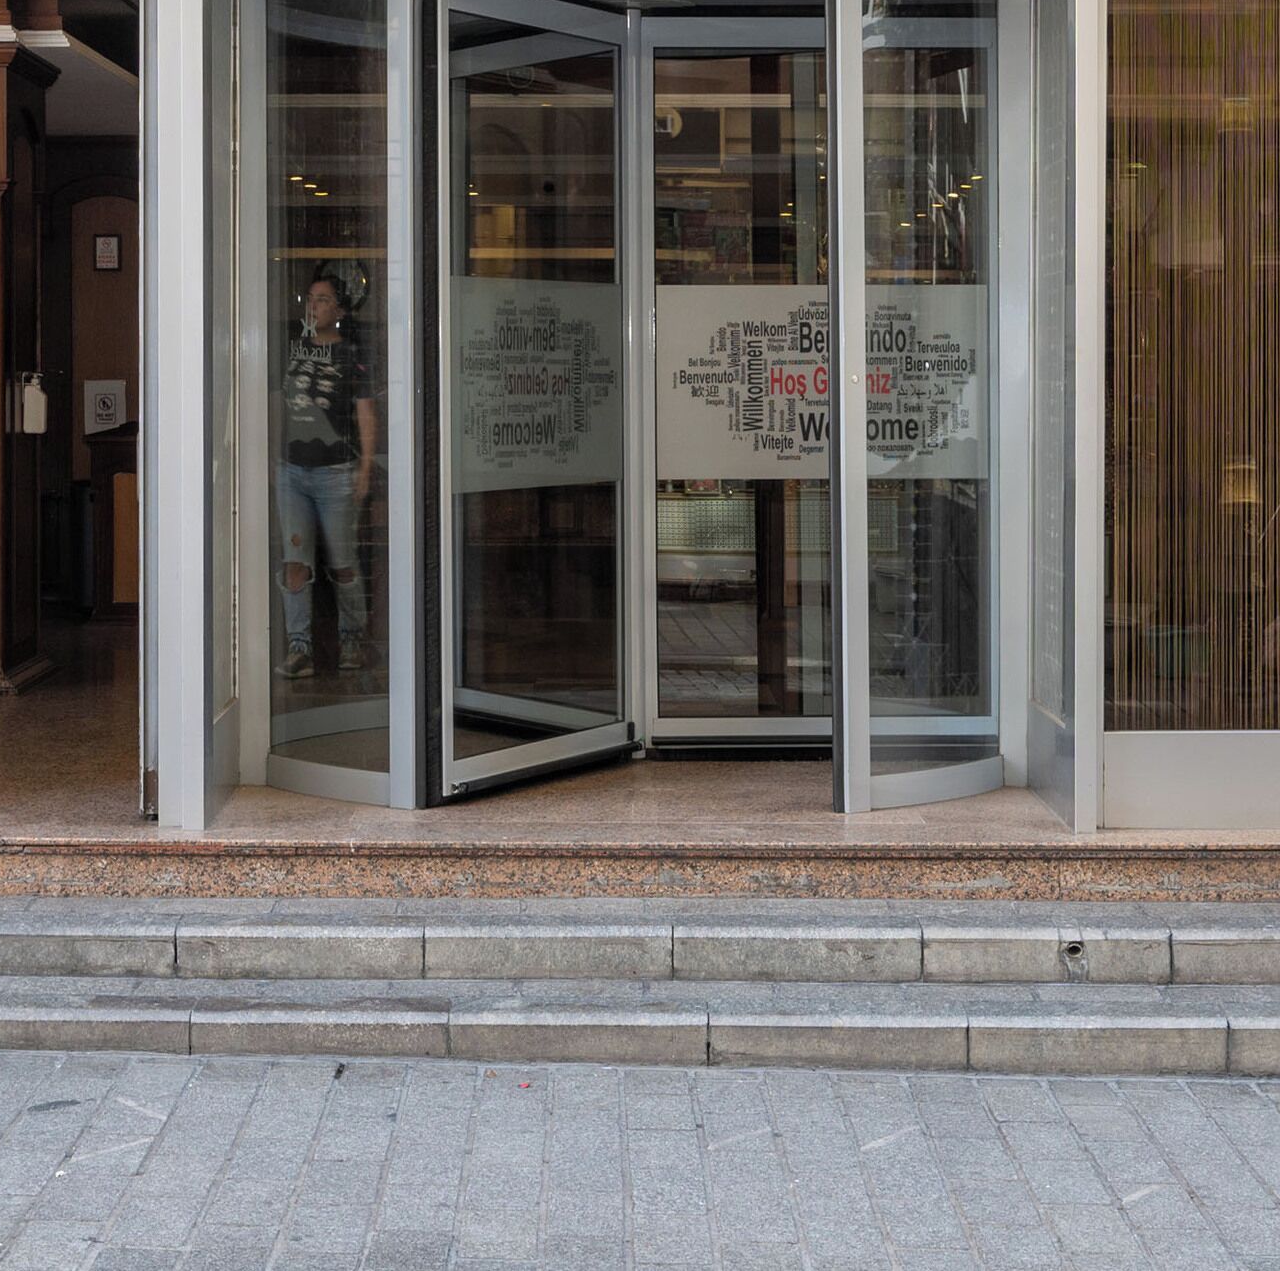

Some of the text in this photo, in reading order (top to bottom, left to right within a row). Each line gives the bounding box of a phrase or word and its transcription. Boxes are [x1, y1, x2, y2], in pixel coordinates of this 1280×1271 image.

[743, 321, 788, 338] Welkom
[917, 341, 961, 354] Tervetuloa
[905, 354, 968, 373] Bienvenido
[679, 370, 735, 385] Benvenuto
[743, 340, 763, 432] Willkommen
[771, 367, 808, 401] Hoş
[799, 413, 919, 442] Wome
[761, 434, 794, 453] Vitejte
